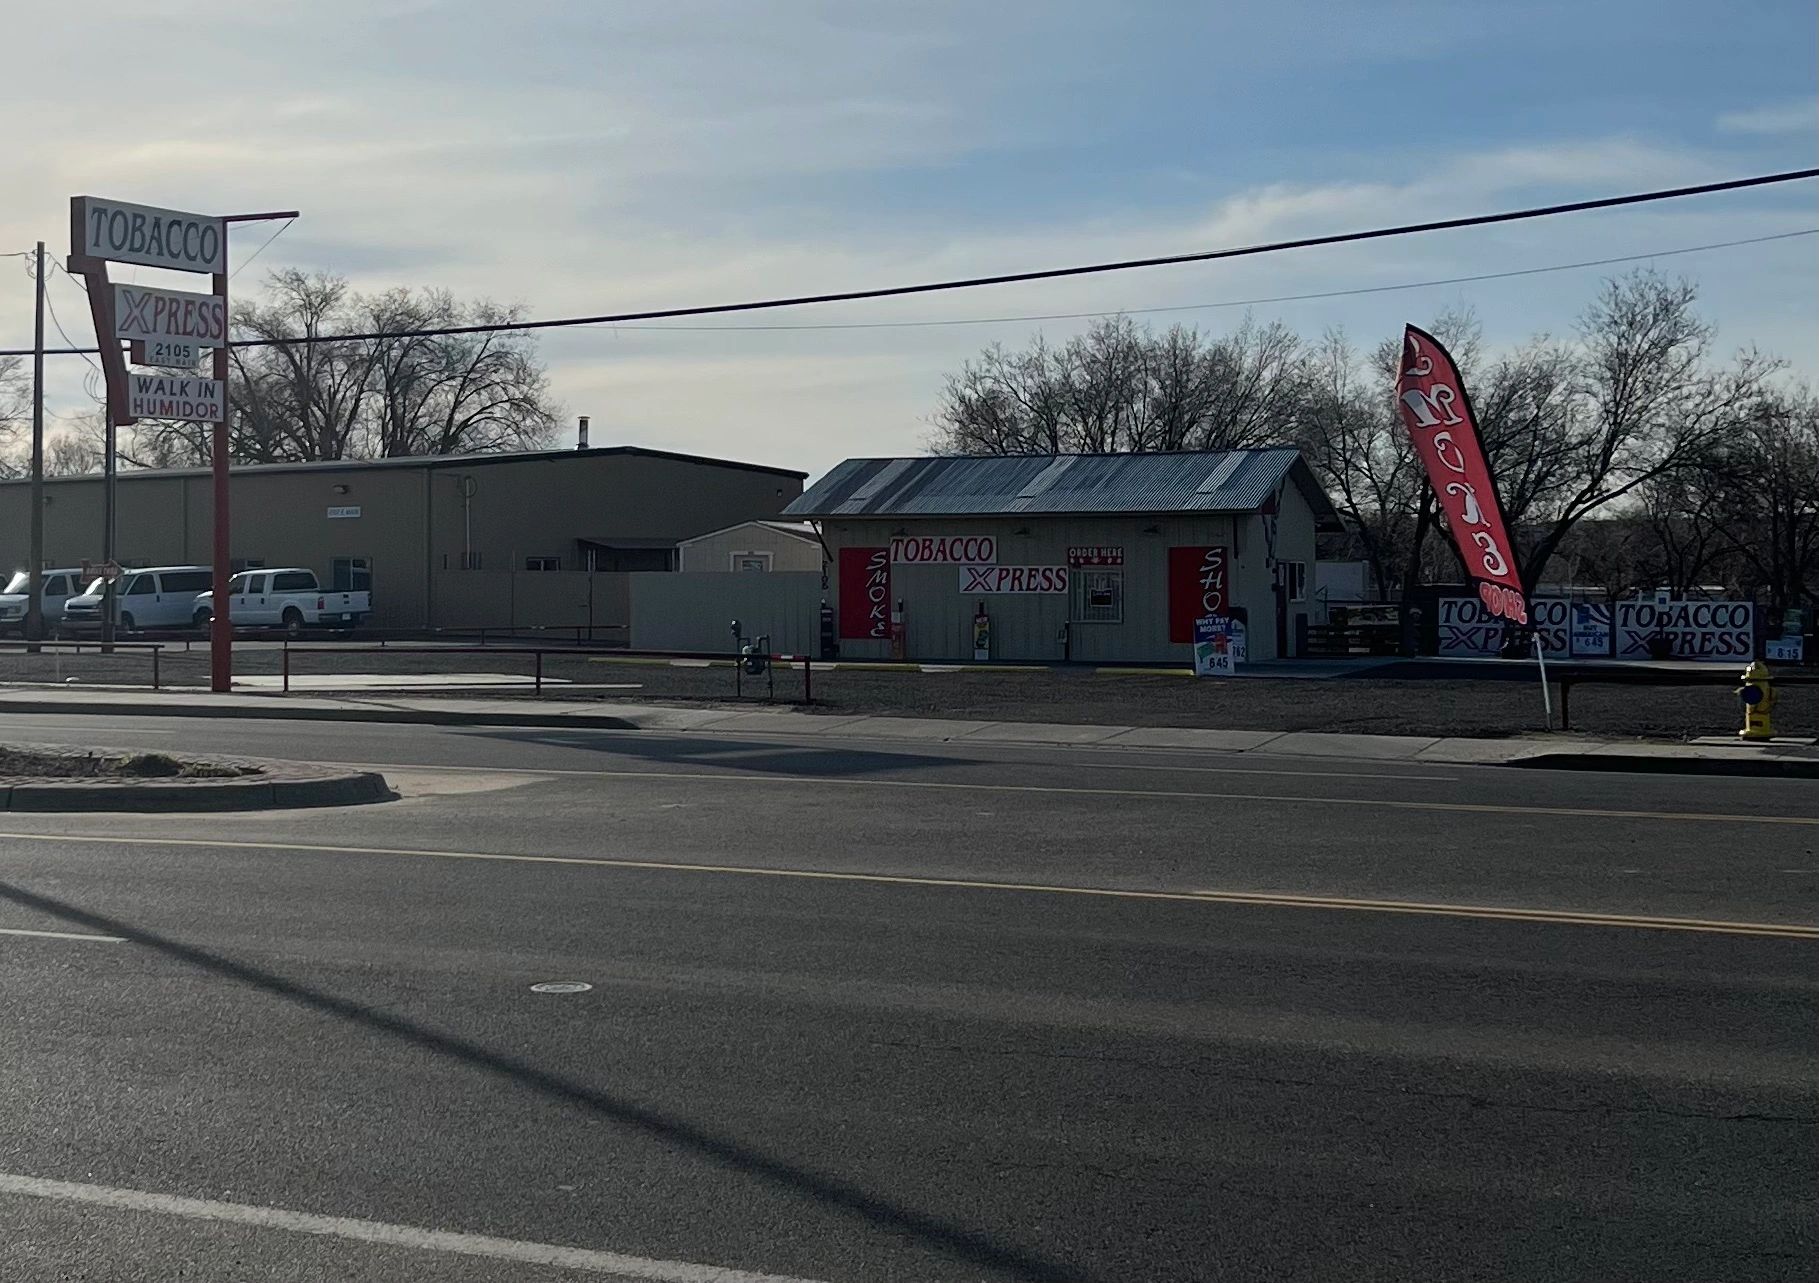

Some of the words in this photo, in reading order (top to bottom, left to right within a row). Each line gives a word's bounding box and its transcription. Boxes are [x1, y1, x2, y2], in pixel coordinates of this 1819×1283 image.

[91, 207, 218, 264] TOBACCO
[119, 290, 222, 339] XPRESS
[156, 343, 190, 358] 2105
[137, 377, 190, 397] WALK
[198, 382, 215, 398] IN
[133, 398, 218, 418] HUMIDOR
[892, 538, 994, 562] TOBACCO
[1069, 548, 1098, 557] ORDER
[1101, 547, 1122, 557] HERE
[963, 567, 1067, 592] XPRESS
[1199, 548, 1222, 617] SHO
[865, 551, 887, 638] SMOKE
[1214, 617, 1230, 625] PAY
[1619, 604, 1749, 628] TOBACCO
